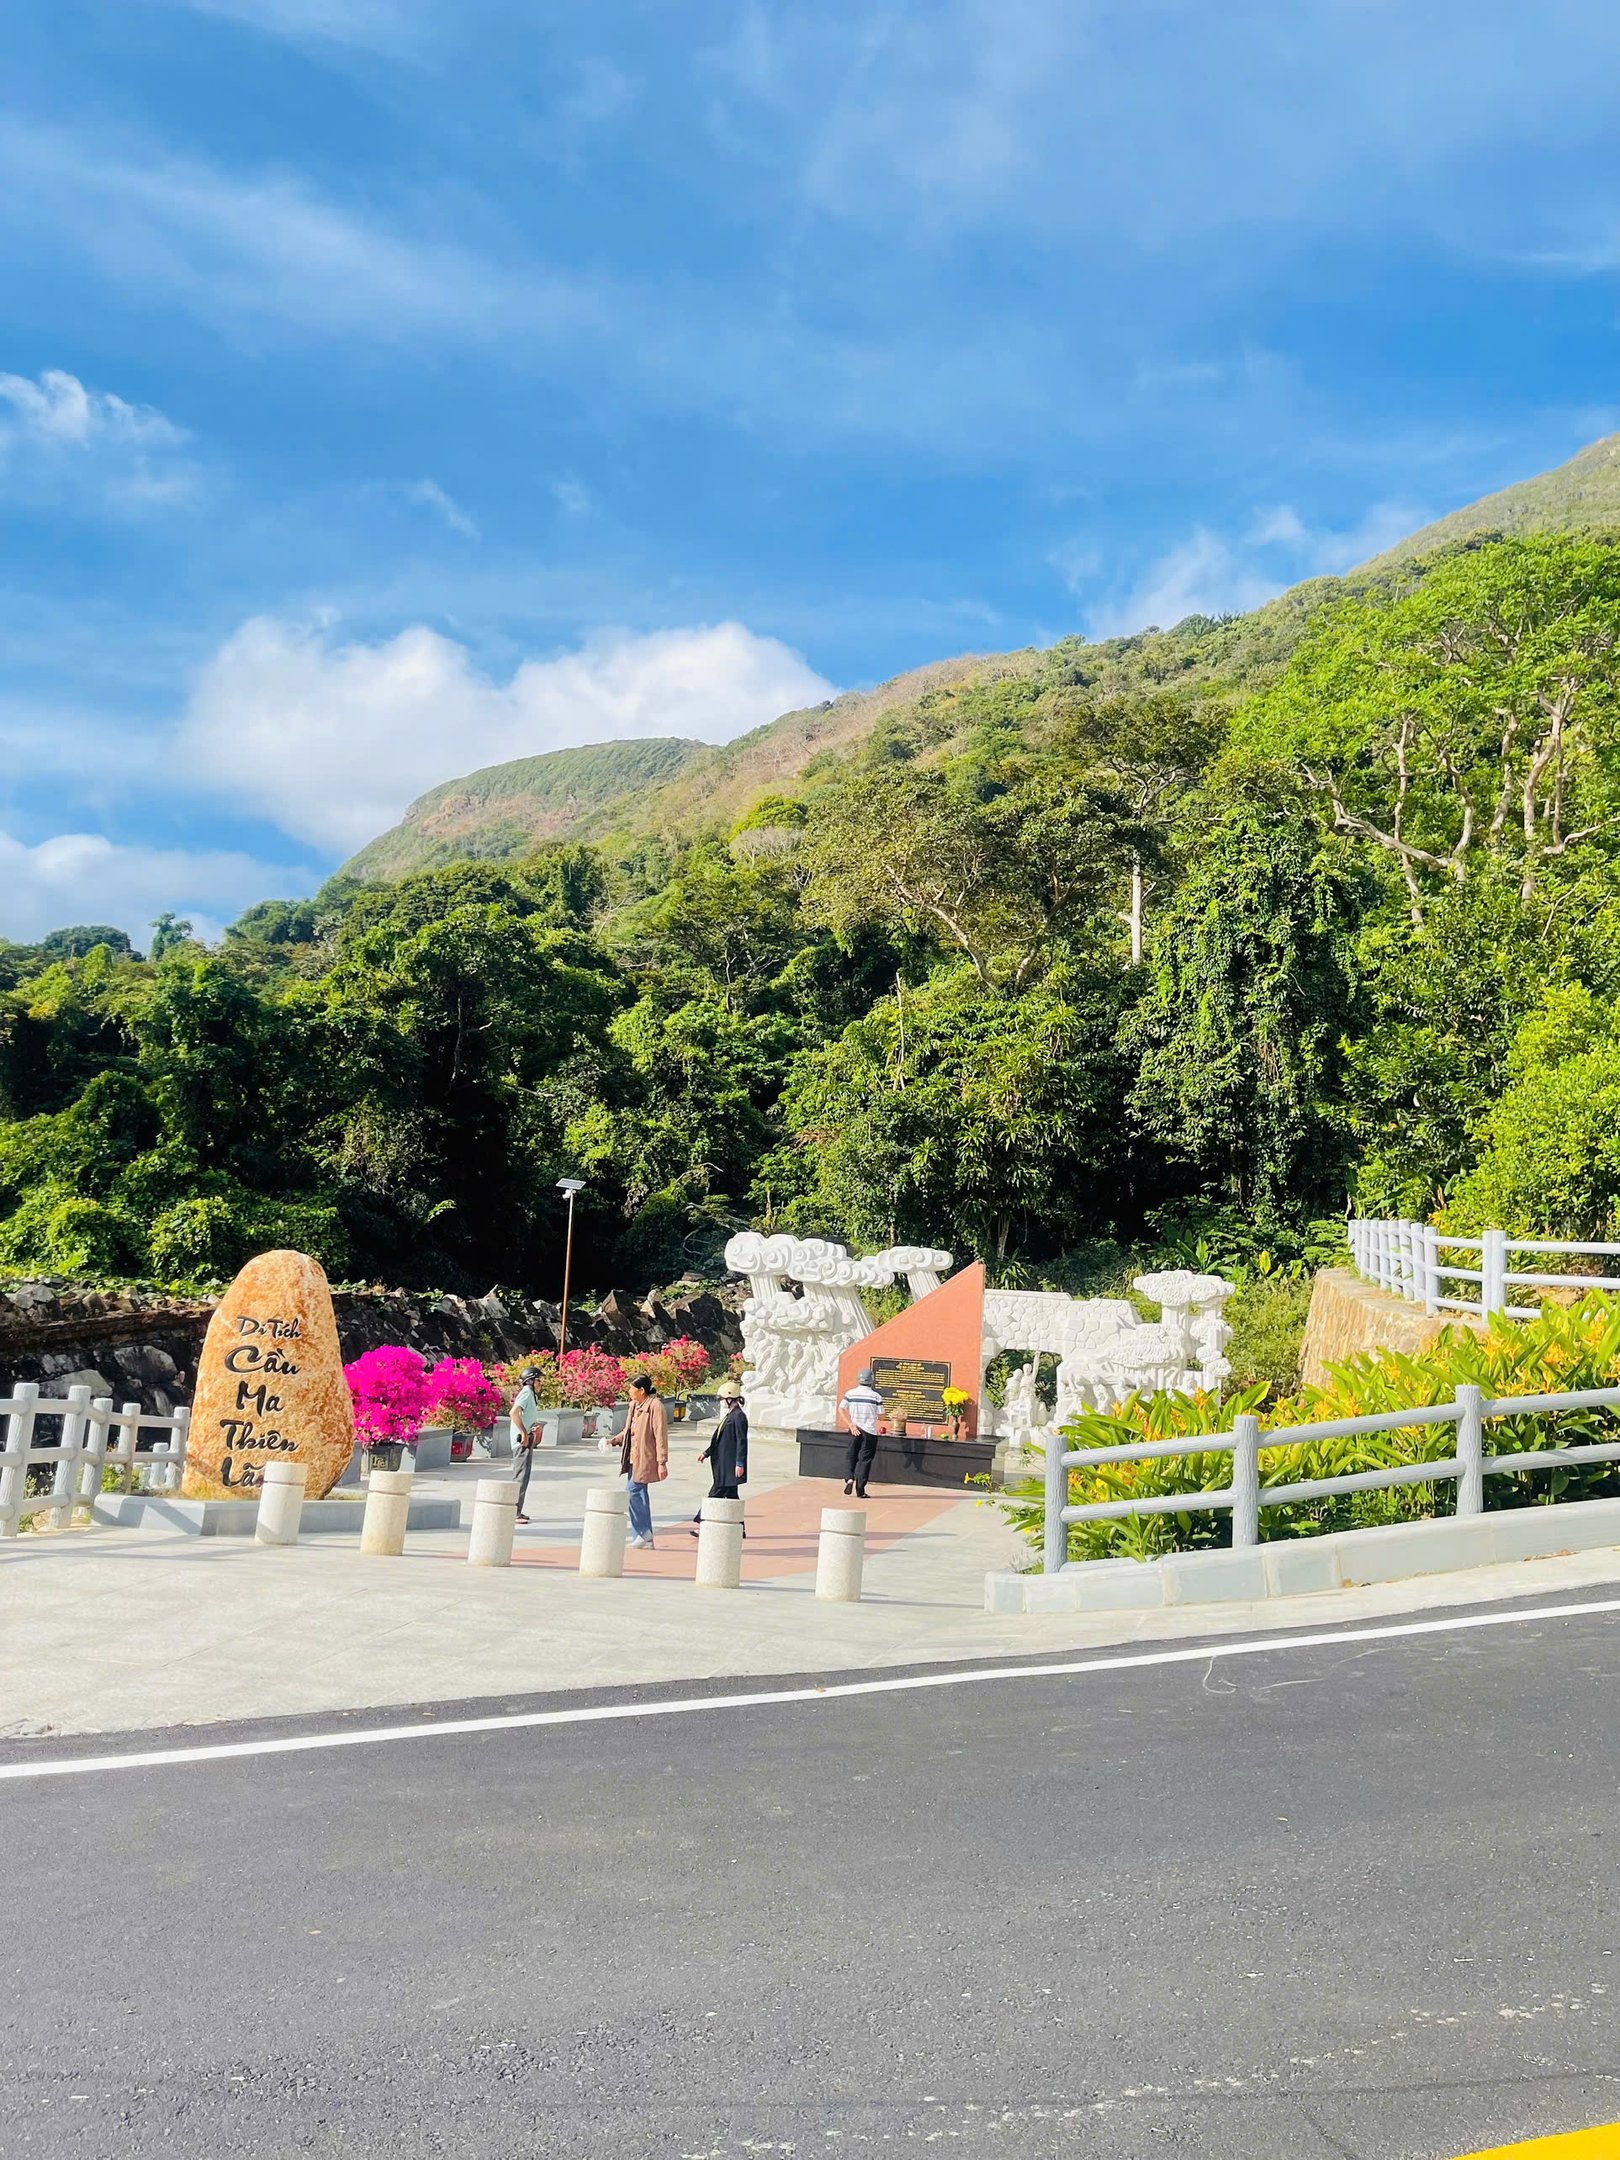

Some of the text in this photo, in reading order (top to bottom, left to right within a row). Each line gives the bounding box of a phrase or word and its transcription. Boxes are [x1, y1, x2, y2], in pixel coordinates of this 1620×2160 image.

[237, 1315, 301, 1338] Di Tích
[225, 1345, 301, 1375] Cầu
[236, 1381, 284, 1417] Ma
[220, 1419, 299, 1452] Thiên
